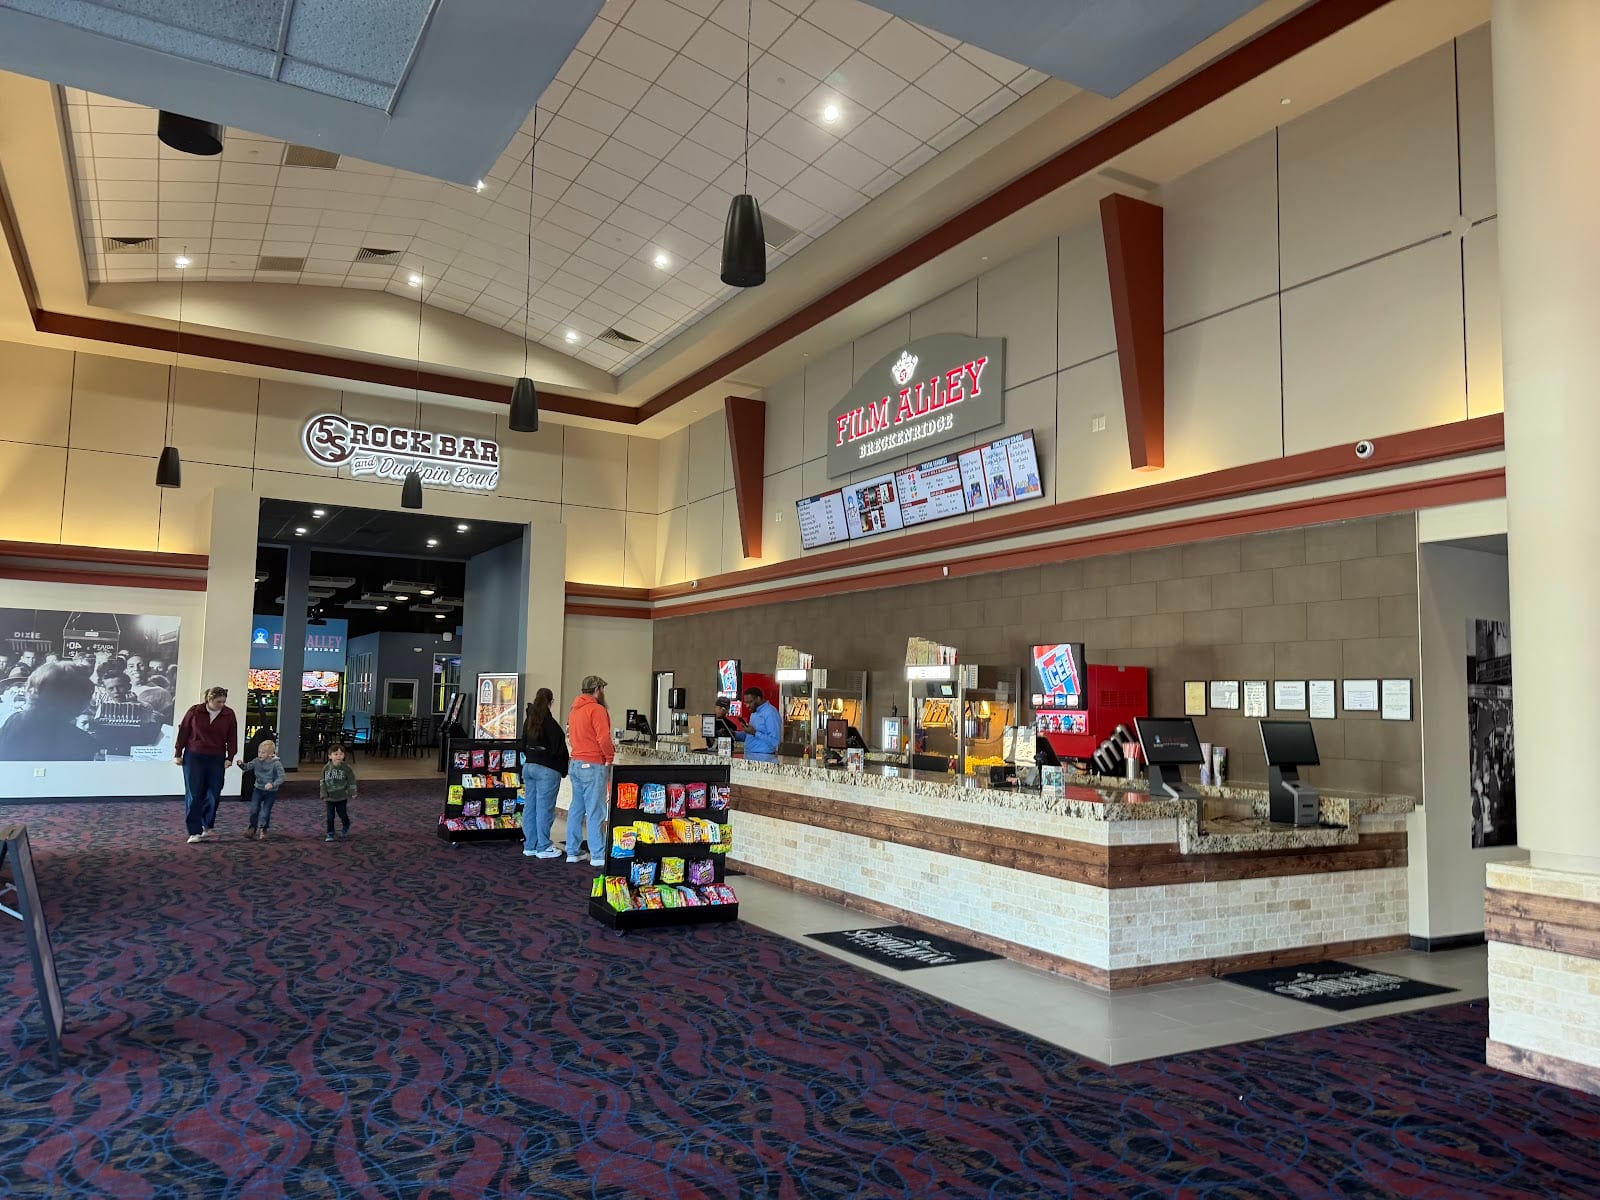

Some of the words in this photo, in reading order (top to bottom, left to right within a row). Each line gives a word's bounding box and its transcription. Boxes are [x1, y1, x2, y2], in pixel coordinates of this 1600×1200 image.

[836, 395, 890, 446] FILM
[894, 356, 988, 424] ALLEY
[350, 424, 432, 454] ROCK
[439, 436, 499, 463] BAR
[859, 413, 954, 458] BRECKENRIDGE
[354, 456, 376, 471] and
[455, 467, 498, 488] Bowl
[307, 634, 342, 648] ALLEY
[1046, 658, 1073, 689] ICEE
